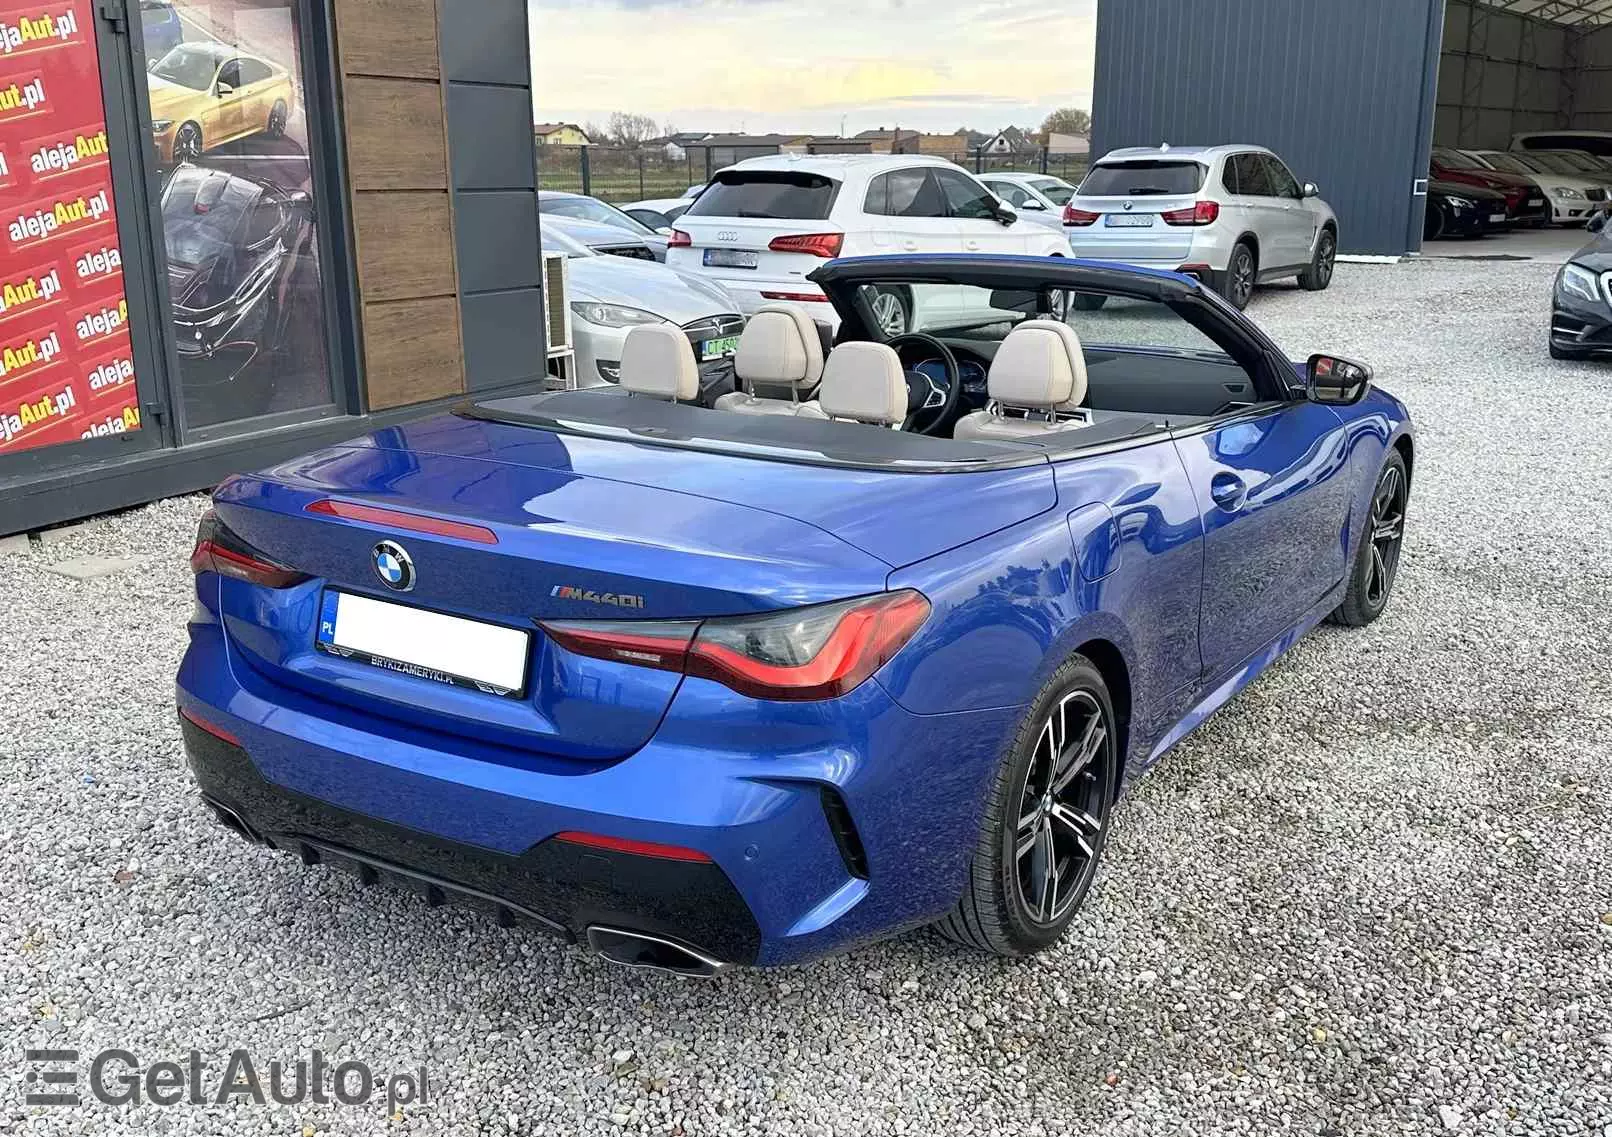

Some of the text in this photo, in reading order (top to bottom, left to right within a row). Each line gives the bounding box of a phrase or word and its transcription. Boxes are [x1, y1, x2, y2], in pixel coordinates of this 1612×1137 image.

[0, 79, 46, 110] ut.pl
[31, 131, 109, 173] alejaAut
[9, 190, 110, 242] alejaAut.pl
[76, 248, 122, 278] aleja
[550, 585, 644, 609] M440i
[322, 621, 334, 635] PL
